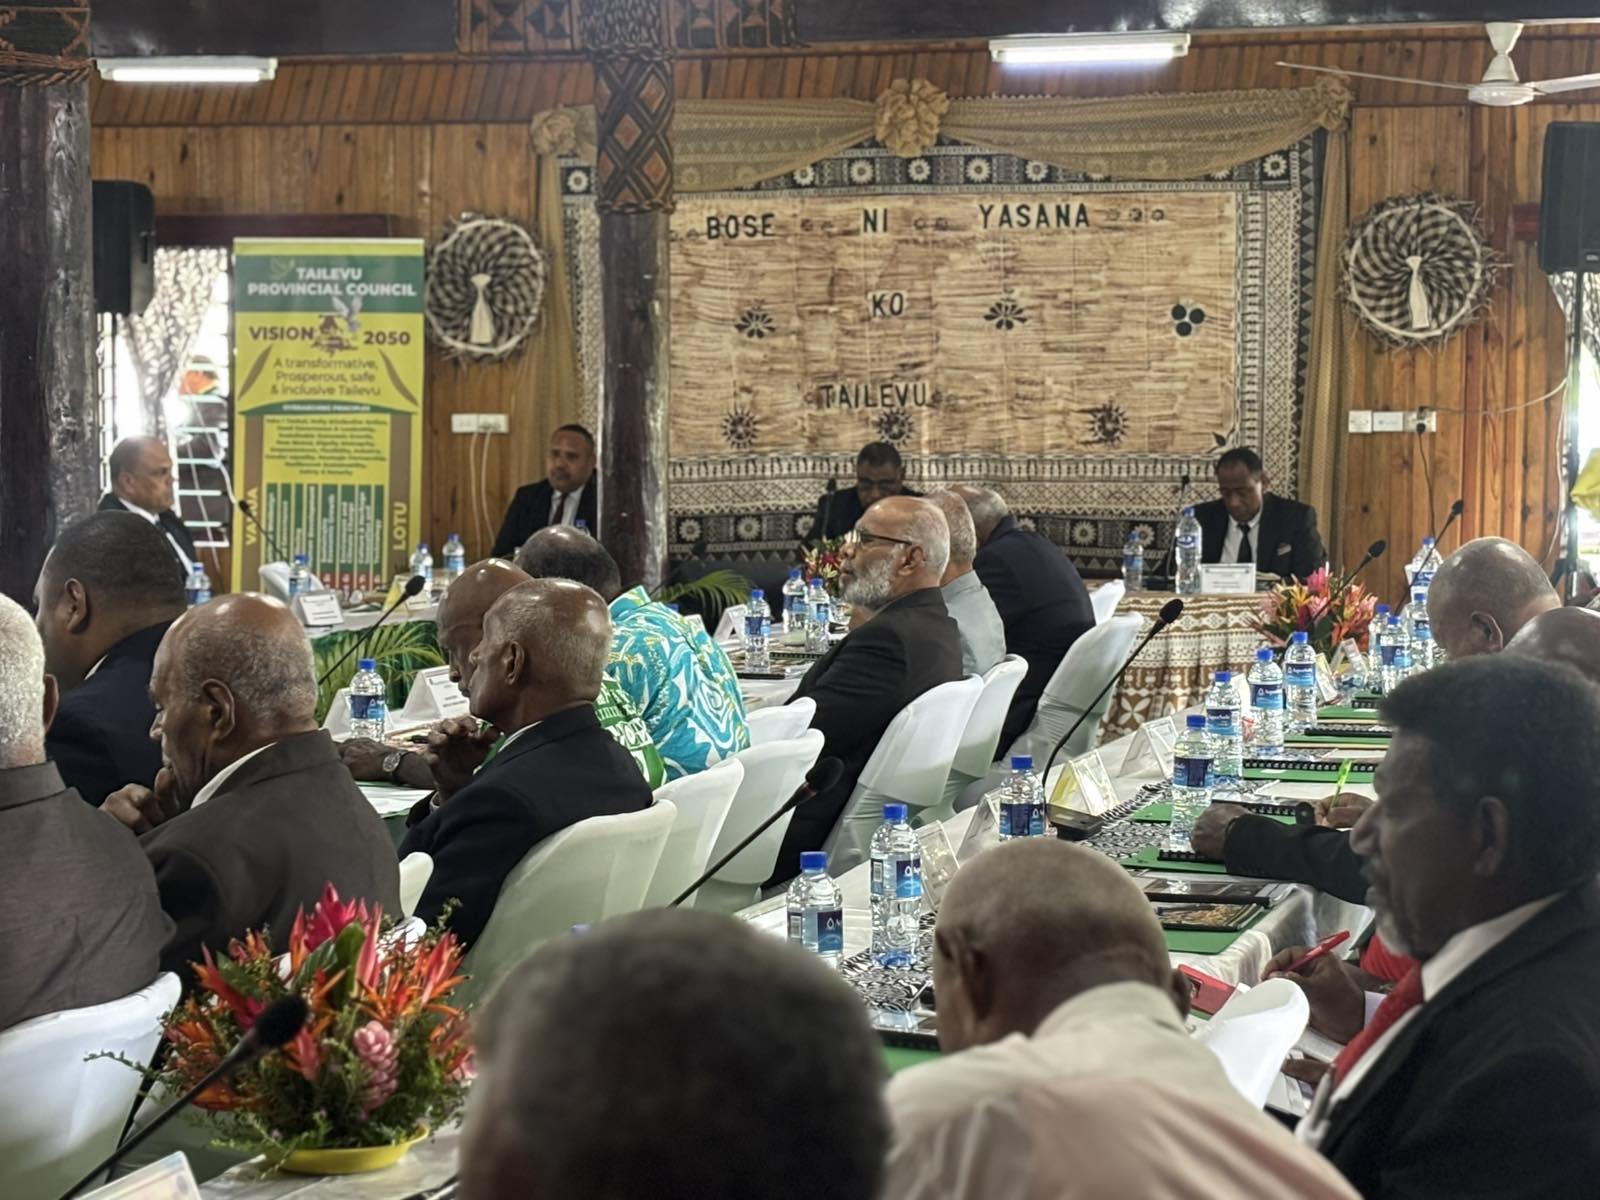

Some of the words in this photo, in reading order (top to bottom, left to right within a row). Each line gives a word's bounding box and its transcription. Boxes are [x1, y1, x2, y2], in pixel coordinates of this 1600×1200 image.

[706, 212, 776, 239] BOSE
[862, 208, 889, 233] NI
[979, 203, 1090, 230] YASANA
[296, 267, 363, 280] TAILEVU
[247, 283, 343, 296] PROVINCIAL
[346, 283, 416, 296] COUNCIL
[871, 292, 905, 318] KO
[249, 326, 315, 341] VISION
[363, 331, 411, 345] 2050
[273, 358, 282, 369] A
[285, 358, 379, 370] transformative,
[351, 373, 376, 383] safe
[271, 384, 279, 394] &
[281, 383, 336, 395] inclusive
[339, 385, 381, 397] Tailevu
[819, 384, 927, 409] TAILEVU
[393, 502, 408, 550] LOTU
